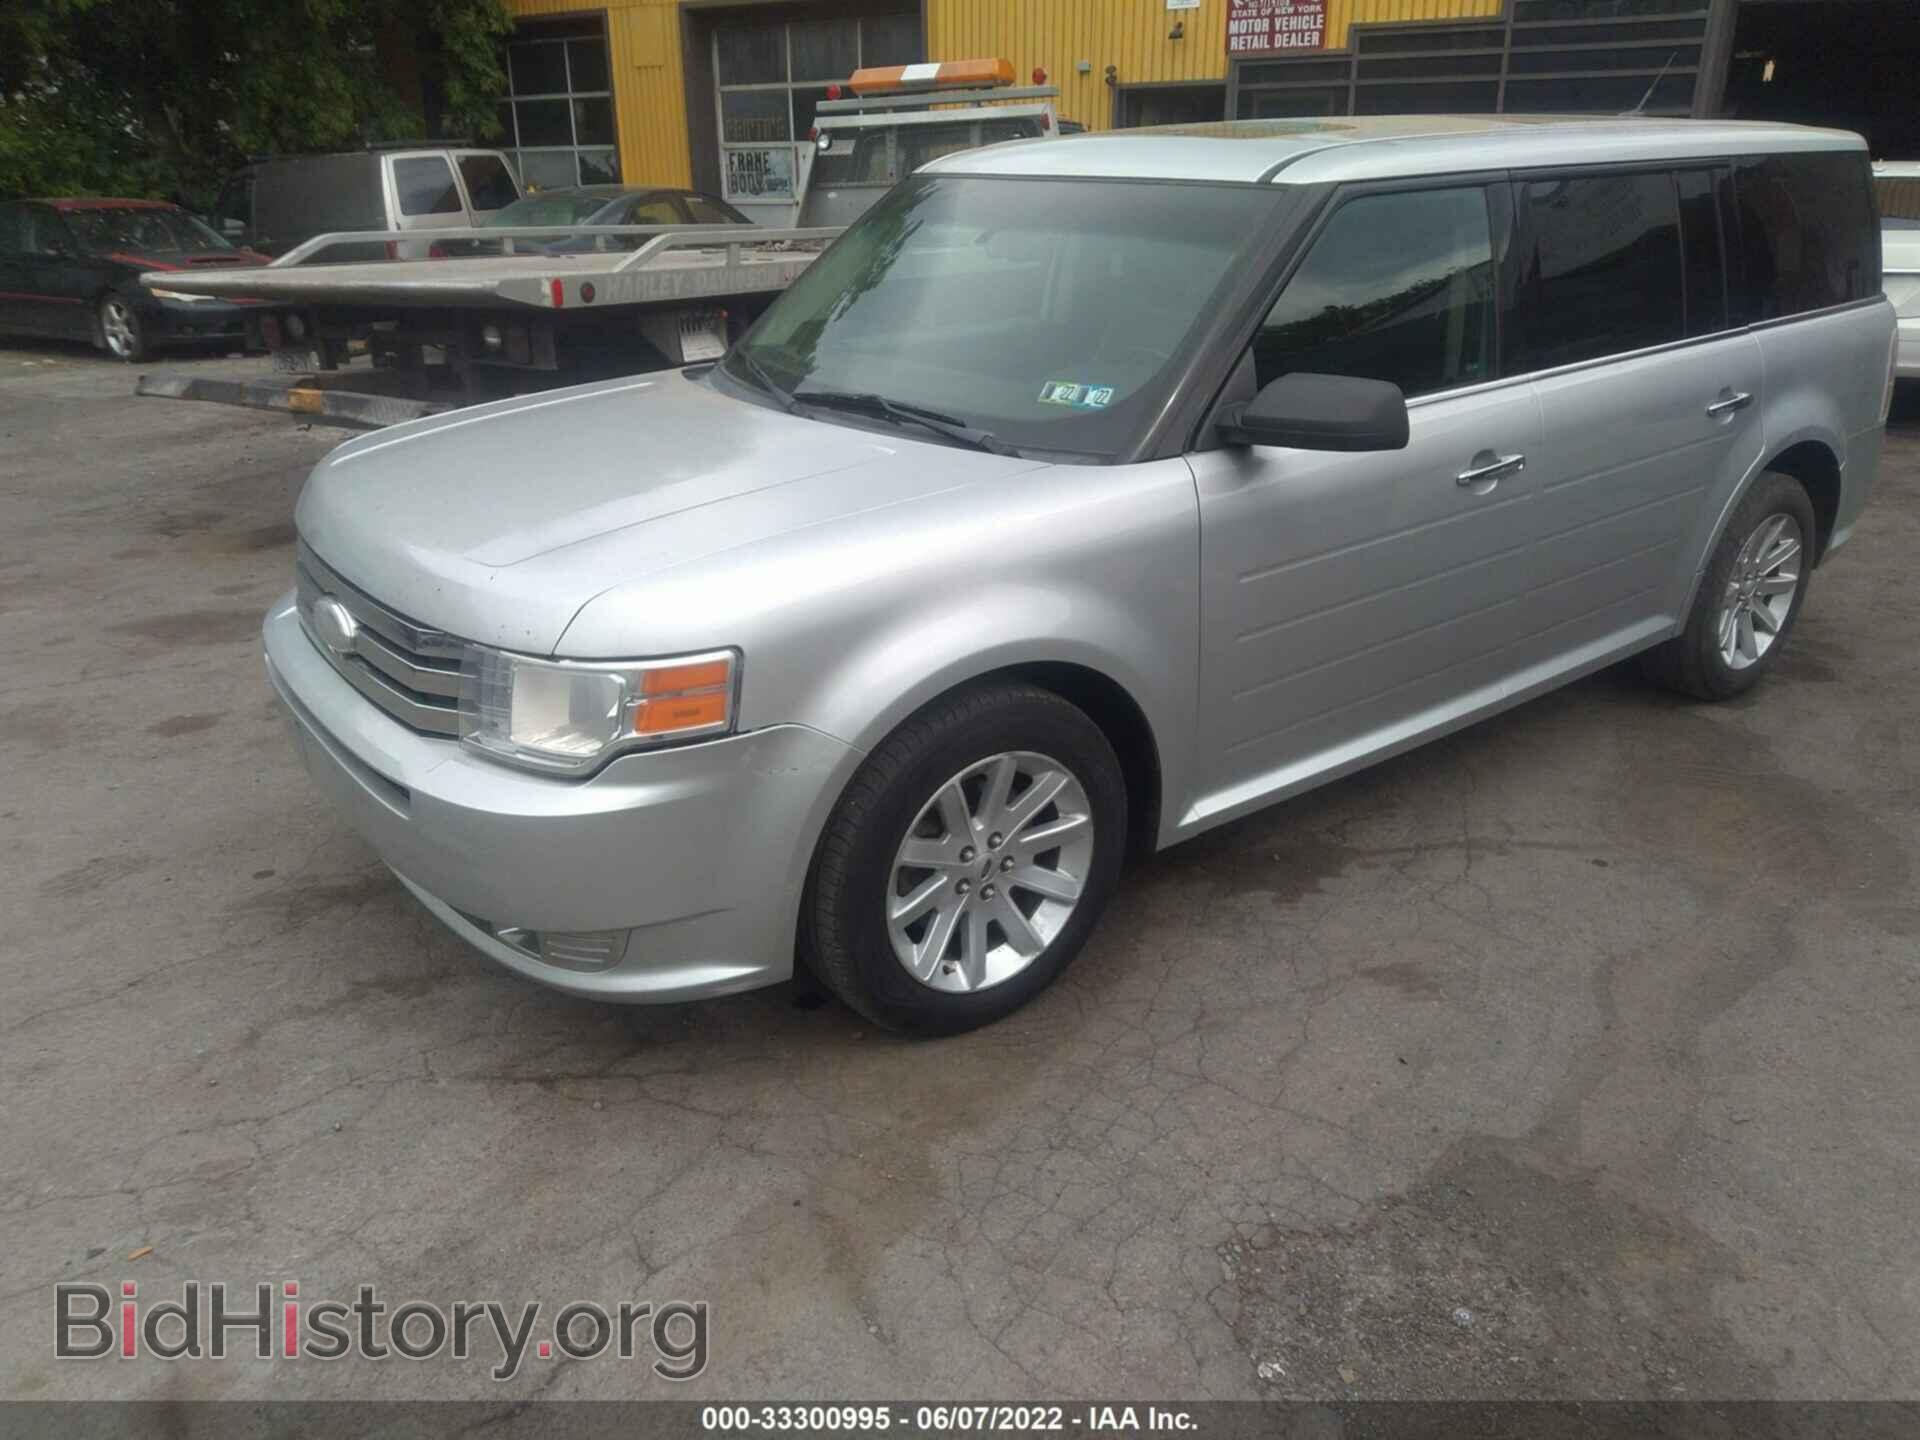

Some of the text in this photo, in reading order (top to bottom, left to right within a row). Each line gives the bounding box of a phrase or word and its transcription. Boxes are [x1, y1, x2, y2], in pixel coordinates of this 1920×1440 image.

[1231, 4, 1322, 18] STATE OF NEW YORK
[1229, 14, 1324, 34] MOTOR VEHICLE
[1230, 31, 1320, 50] RETAIL DEALER
